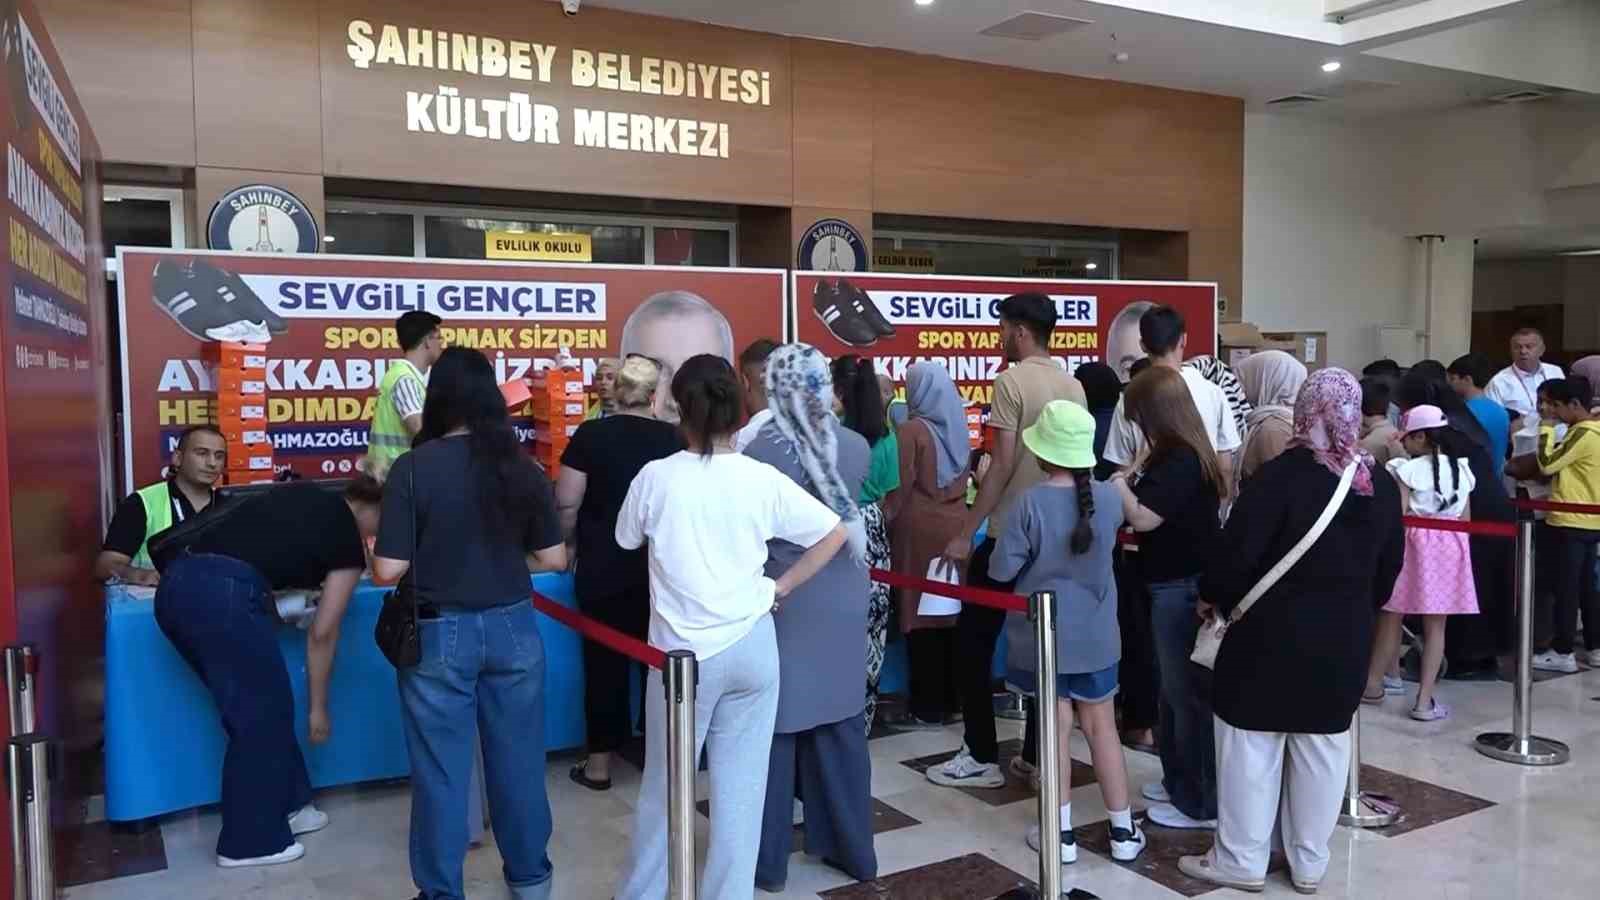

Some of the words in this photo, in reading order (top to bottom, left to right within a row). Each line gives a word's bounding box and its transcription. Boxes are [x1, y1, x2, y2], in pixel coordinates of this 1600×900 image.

[406, 84, 560, 144] KÜLTÜR
[544, 241, 582, 254] OKULU
[437, 285, 596, 317] GENÇLER
[324, 327, 399, 349] SPOR
[440, 327, 515, 349] PMAK
[519, 323, 607, 349] SİZDEN
[918, 331, 965, 349] SPOR
[967, 331, 1003, 349] YAP
[159, 399, 219, 425] HE
[268, 396, 378, 422] DIMDA
